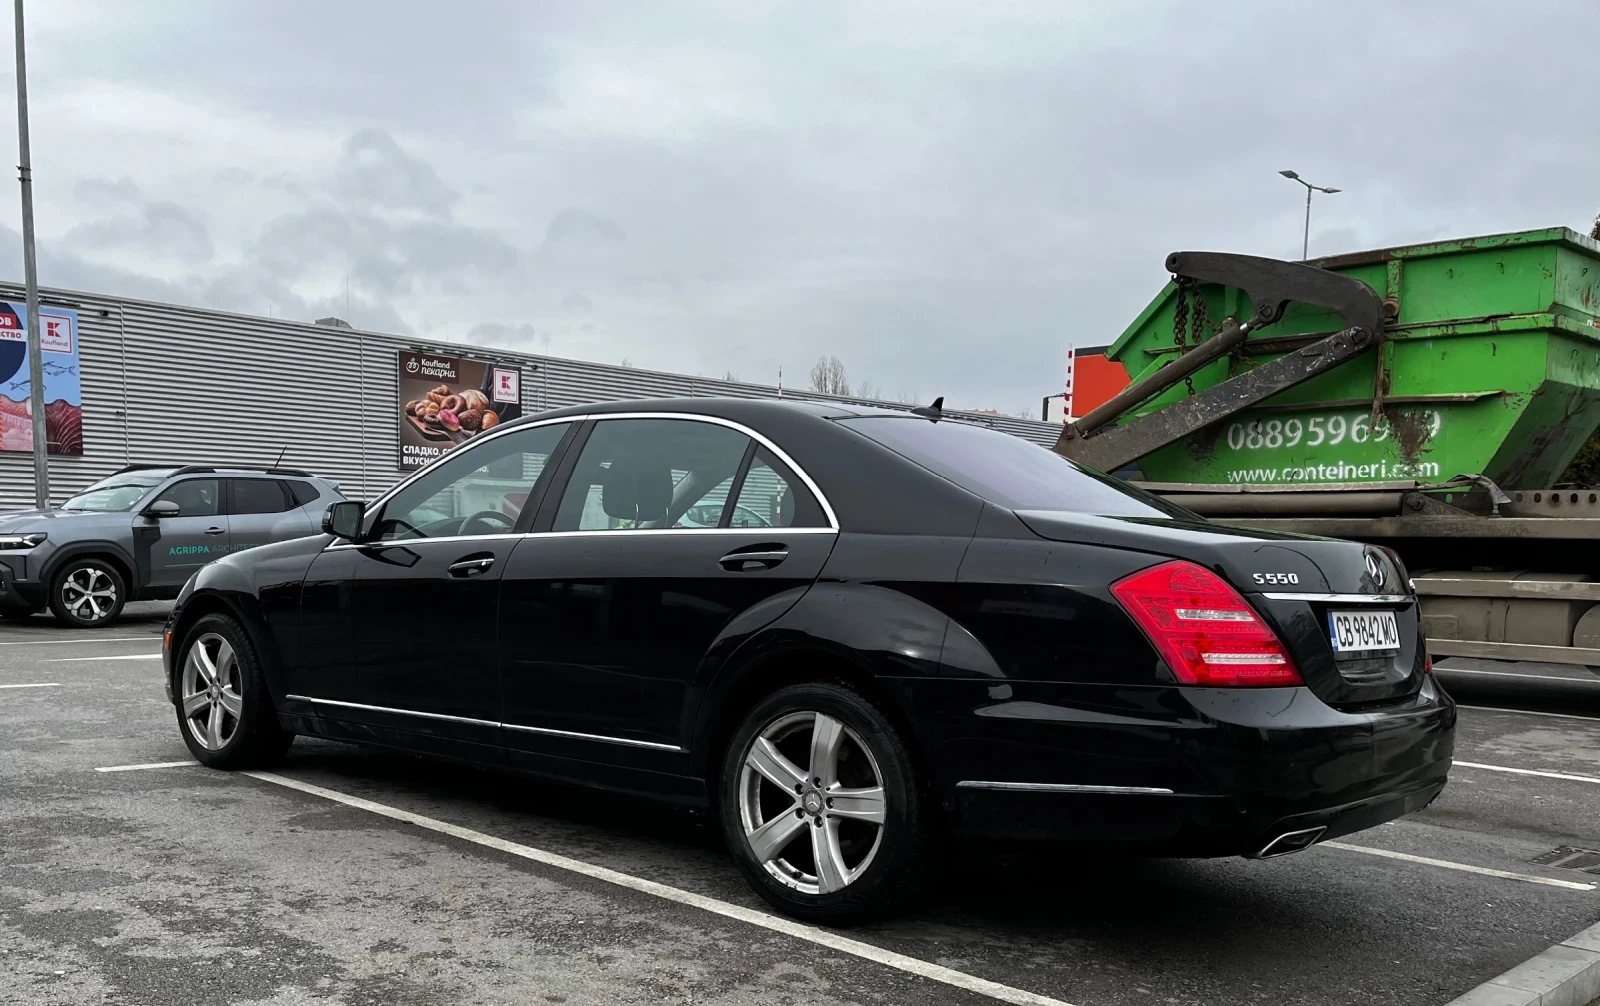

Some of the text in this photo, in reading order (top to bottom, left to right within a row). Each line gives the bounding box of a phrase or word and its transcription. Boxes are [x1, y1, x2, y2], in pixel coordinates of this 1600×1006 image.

[421, 358, 450, 369] Kaufland
[421, 366, 456, 378] пекарна
[1227, 410, 1441, 450] 088959699
[169, 546, 210, 555] AGRIPPA
